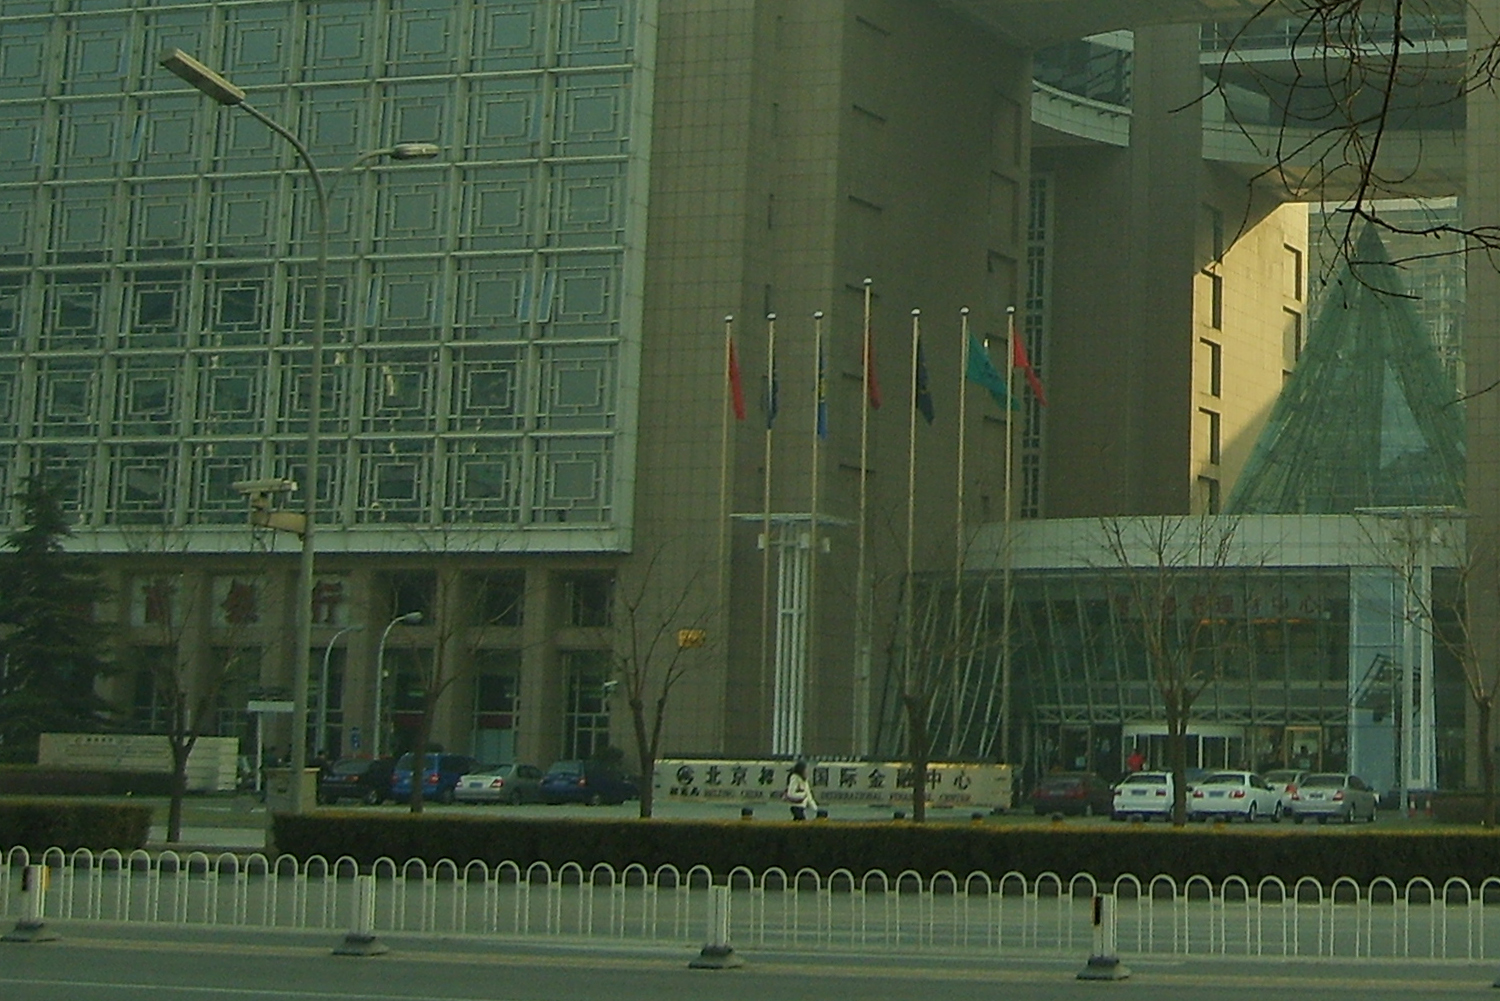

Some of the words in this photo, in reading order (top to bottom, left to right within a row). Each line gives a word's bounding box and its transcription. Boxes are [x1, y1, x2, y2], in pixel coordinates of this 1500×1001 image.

[706, 765, 971, 791] 北京招国际金融中心
